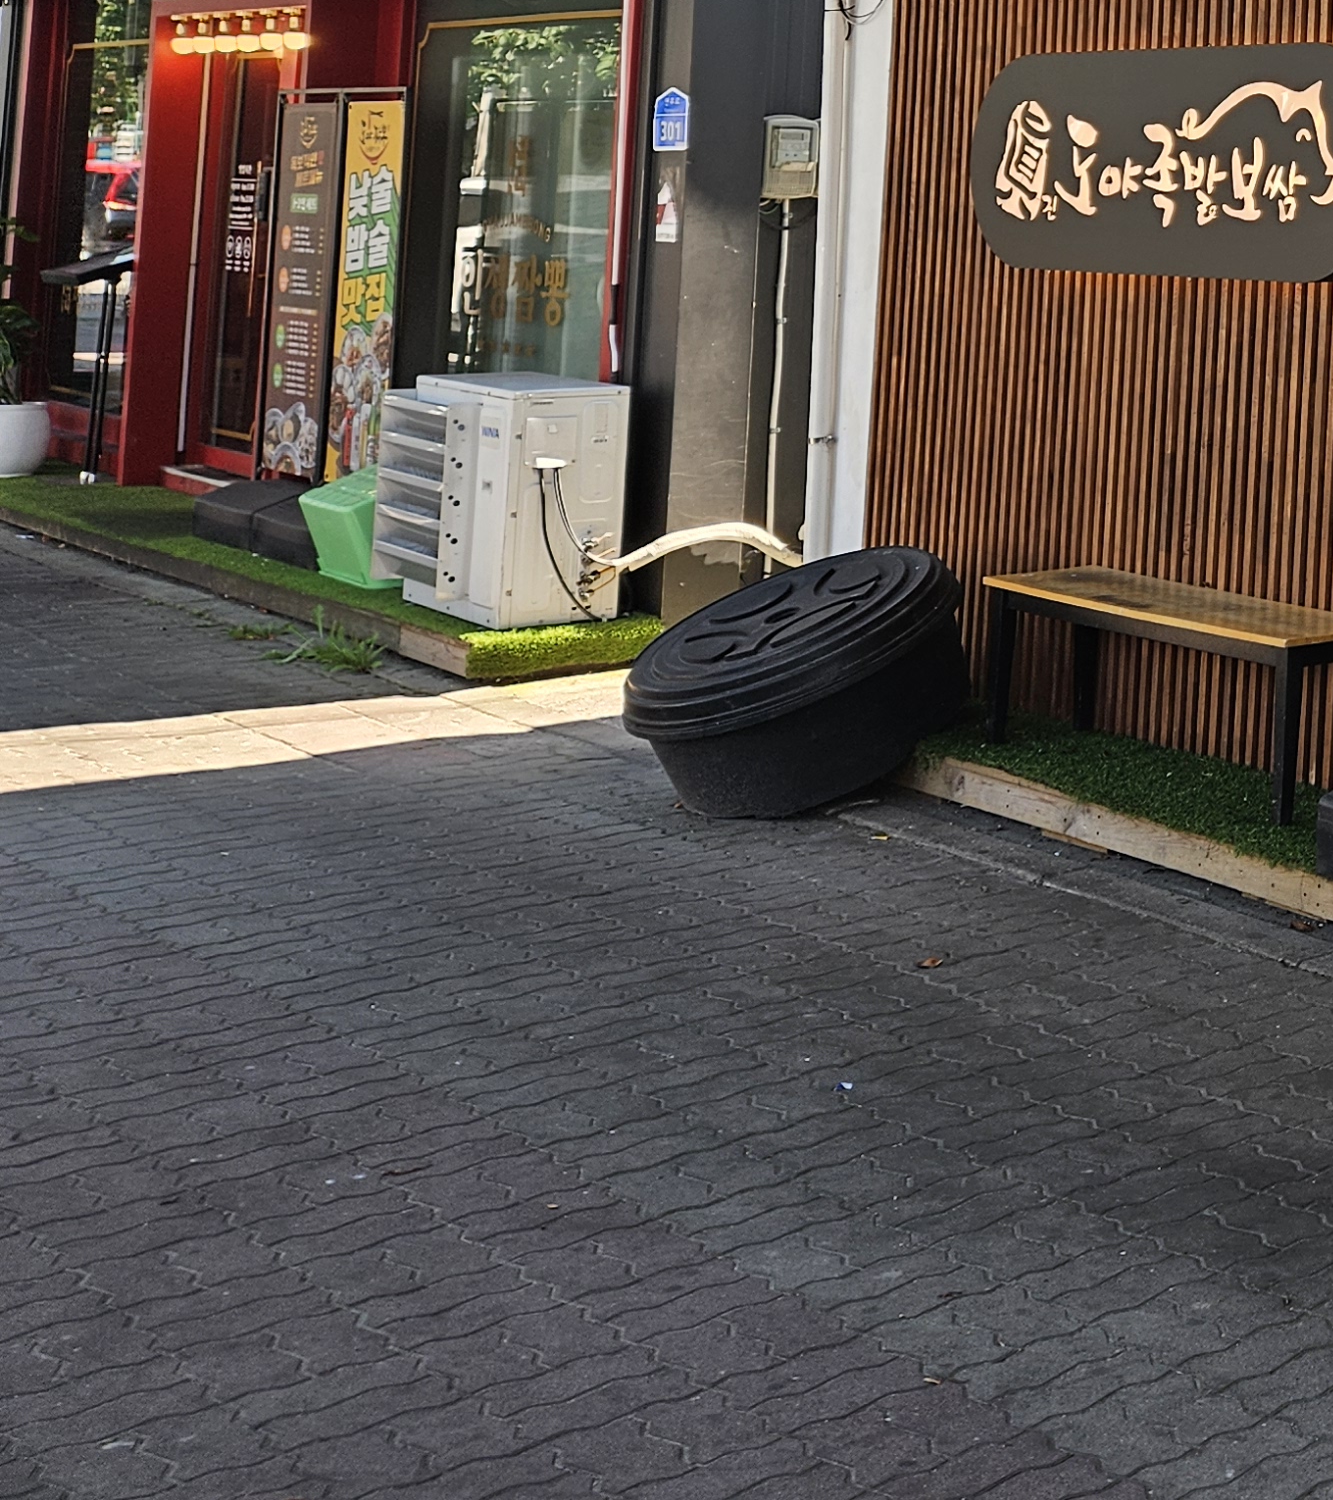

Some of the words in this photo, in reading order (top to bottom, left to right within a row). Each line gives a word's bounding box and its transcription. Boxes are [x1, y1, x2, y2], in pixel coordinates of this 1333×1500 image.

[660, 121, 683, 142] 301
[347, 164, 393, 221] 낮술
[344, 218, 391, 273] 밤술
[340, 272, 388, 328] 맛집
